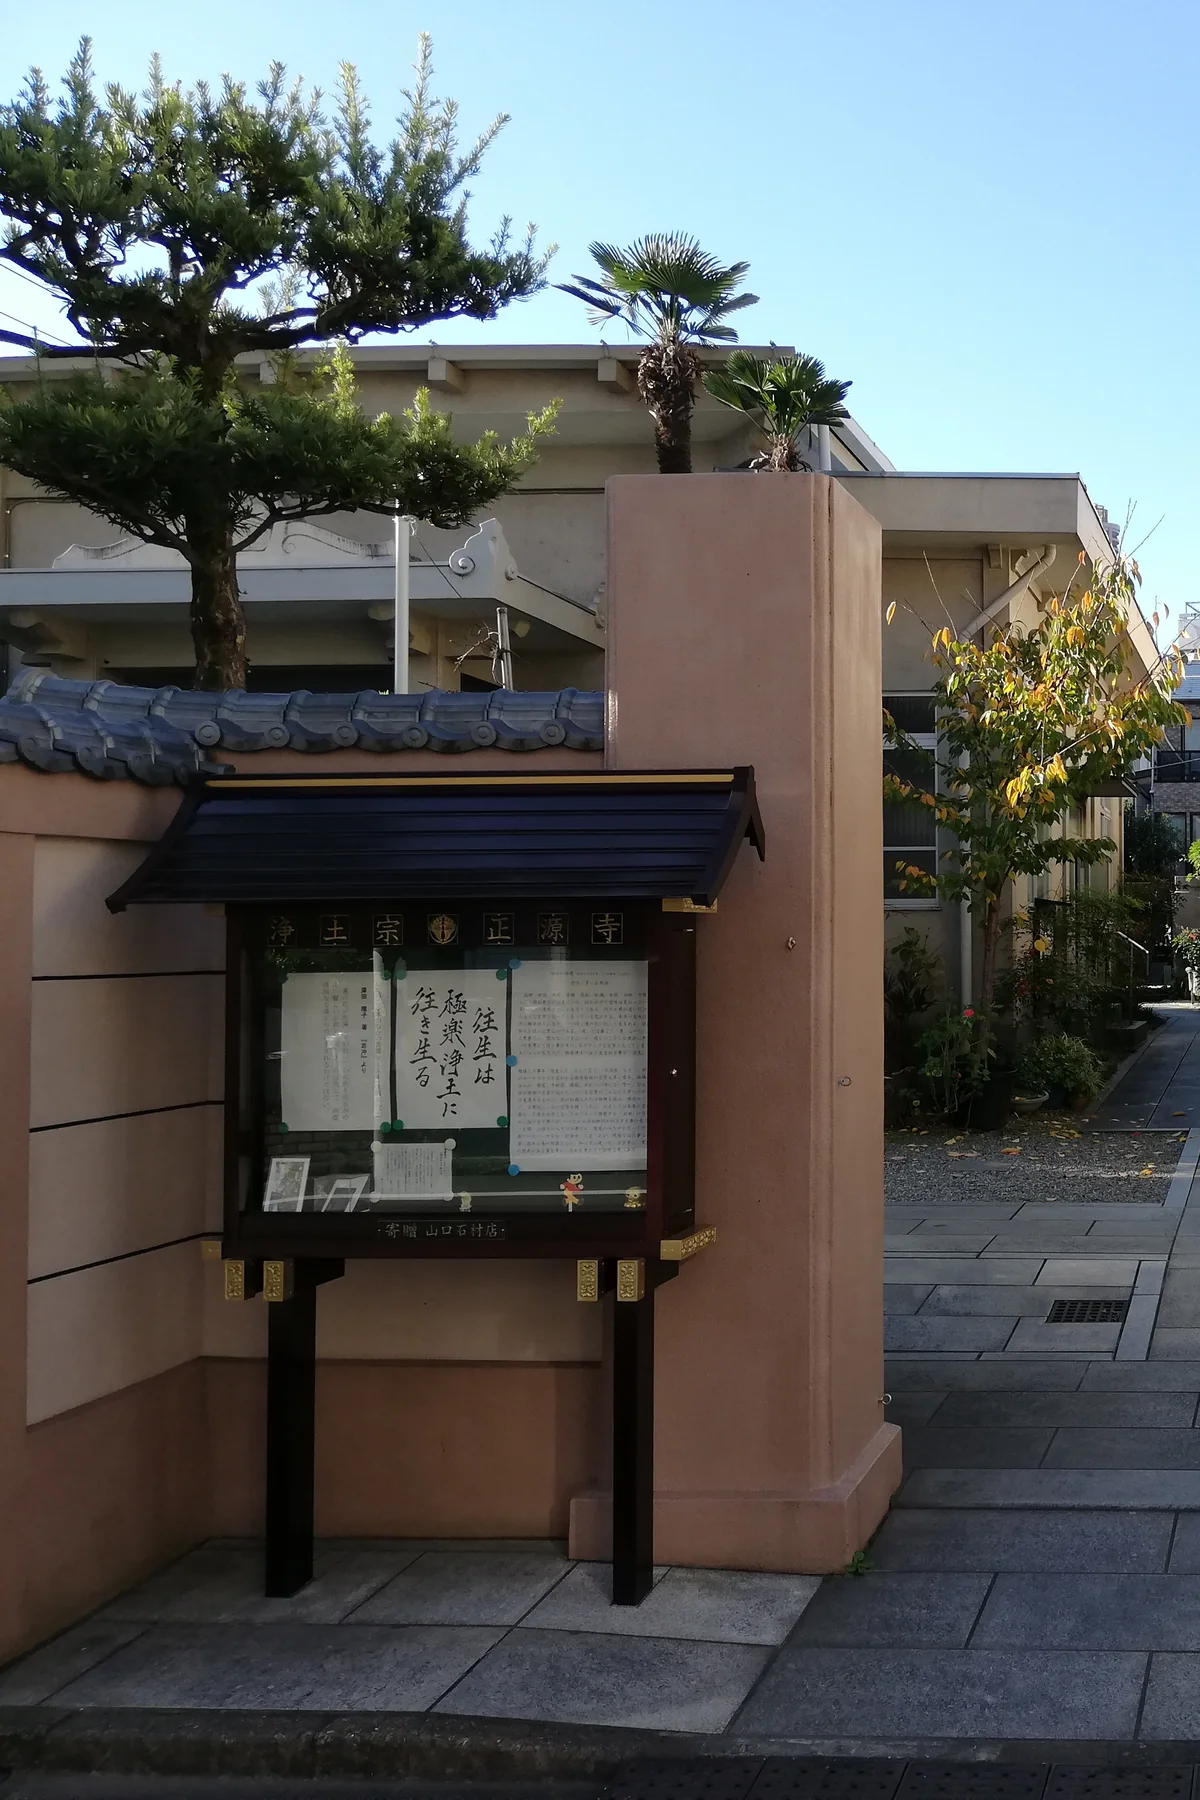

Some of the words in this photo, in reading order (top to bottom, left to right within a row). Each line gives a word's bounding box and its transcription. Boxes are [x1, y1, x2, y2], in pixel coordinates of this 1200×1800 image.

[269, 915, 401, 945] 浄土宗
[487, 915, 621, 945] 正源寺
[409, 986, 439, 1088] 往き生る
[436, 988, 468, 1118] 極楽浄土に
[471, 1006, 499, 1085] 往生は
[384, 1221, 419, 1239] 寄贈
